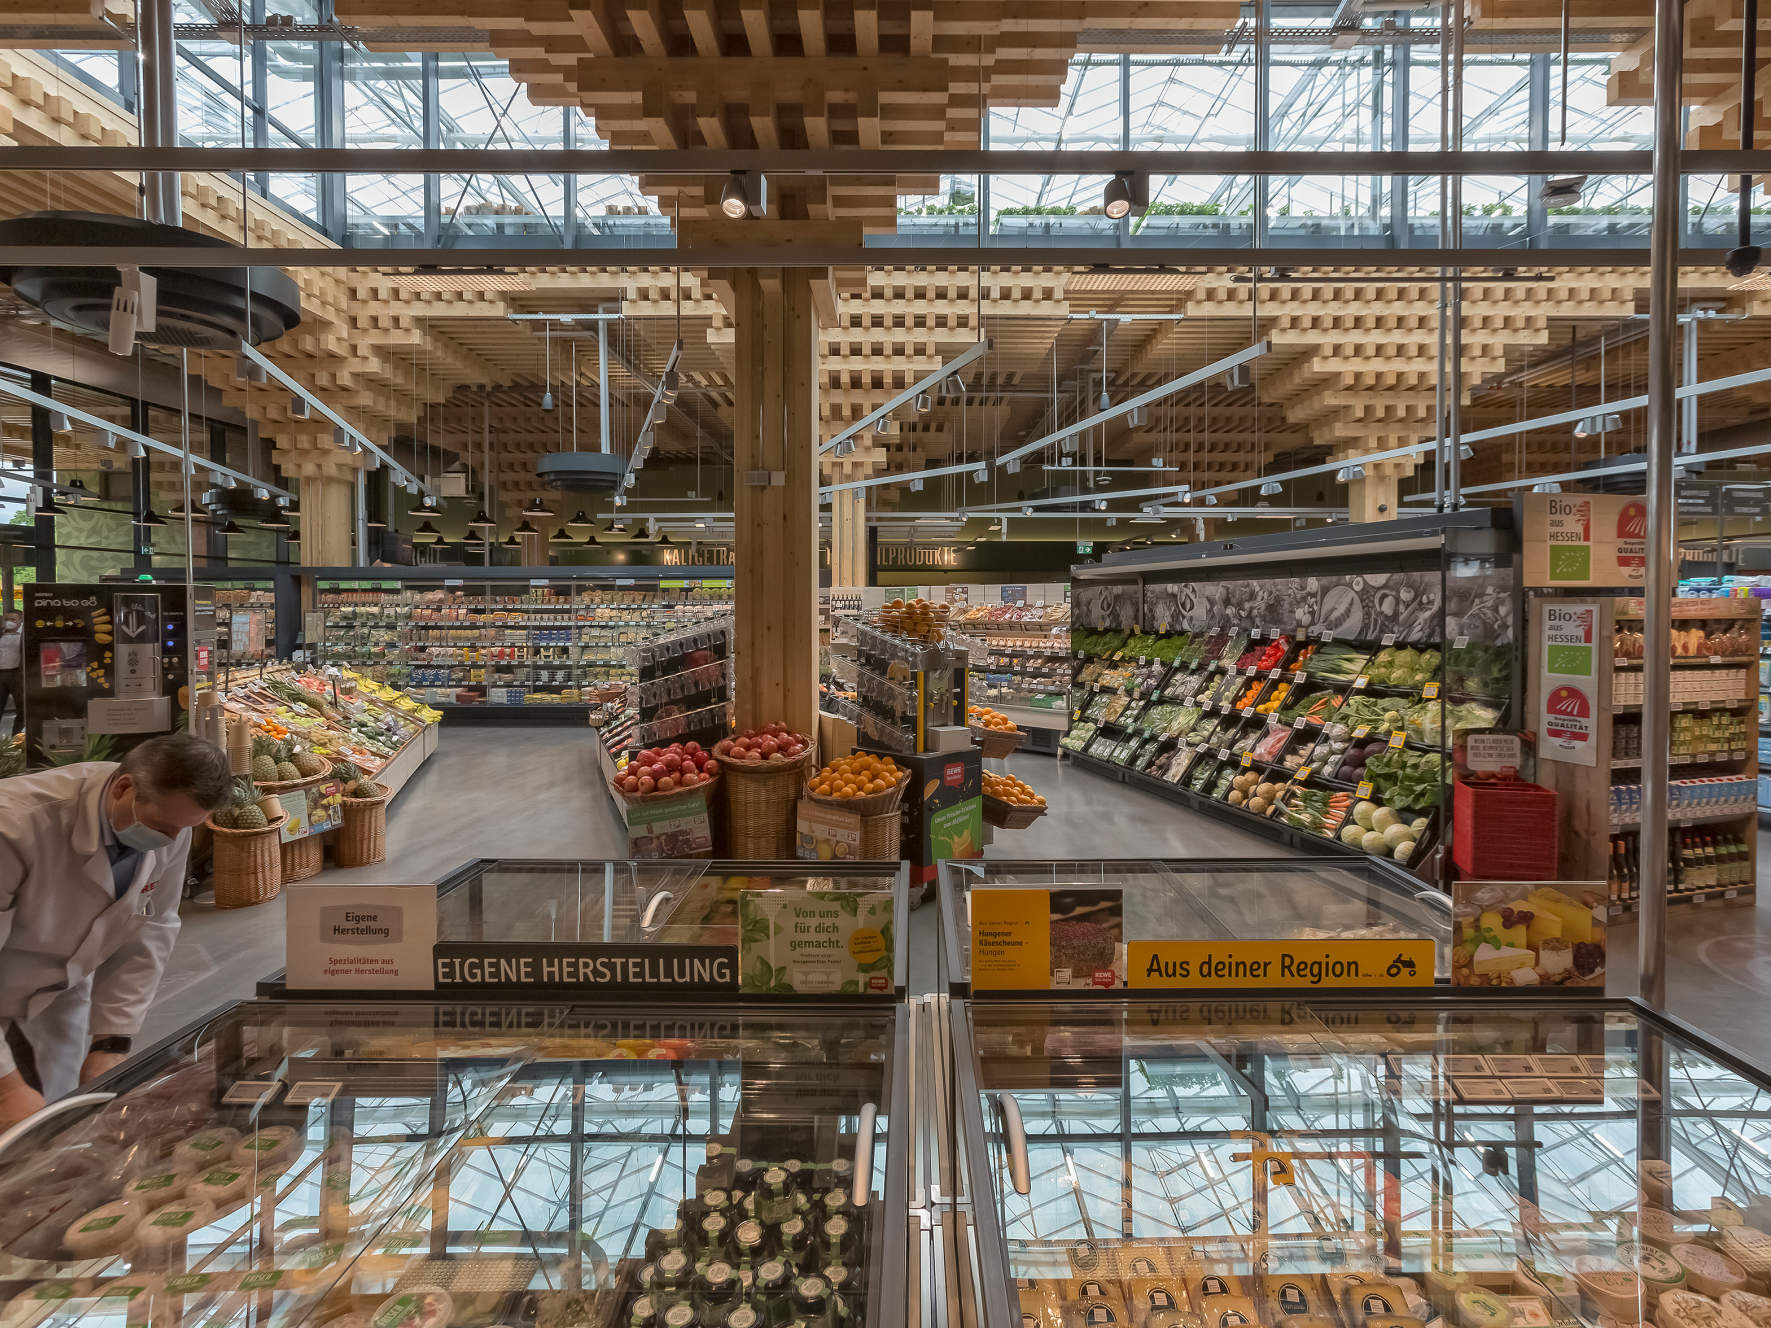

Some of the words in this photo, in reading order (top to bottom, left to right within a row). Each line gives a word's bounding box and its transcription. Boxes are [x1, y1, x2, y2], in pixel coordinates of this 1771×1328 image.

[1549, 499, 1572, 516] Bio
[1549, 519, 1564, 528] aus
[1548, 531, 1582, 542] HESSEN
[1617, 547, 1646, 555] QUALIT
[1547, 608, 1573, 622] Bio
[1547, 624, 1563, 632] aus
[1547, 634, 1583, 644] HESSEN
[1547, 720, 1590, 732] QUALITÄT
[345, 911, 379, 925] Eigene
[793, 907, 816, 919] Von
[818, 908, 840, 919] uns
[333, 924, 390, 938] Herstellung
[794, 921, 811, 934] für
[814, 921, 839, 934] dich
[789, 937, 844, 952] gemacht.
[328, 956, 379, 967] Spezialitäten
[323, 967, 352, 977] eigener
[354, 967, 399, 977] Herstellung
[437, 958, 535, 983] EIGENE
[542, 957, 731, 983] HERSTELLUNG
[1146, 953, 1191, 978] Aus
[1198, 953, 1273, 978] deiner
[1280, 953, 1360, 985] Region
